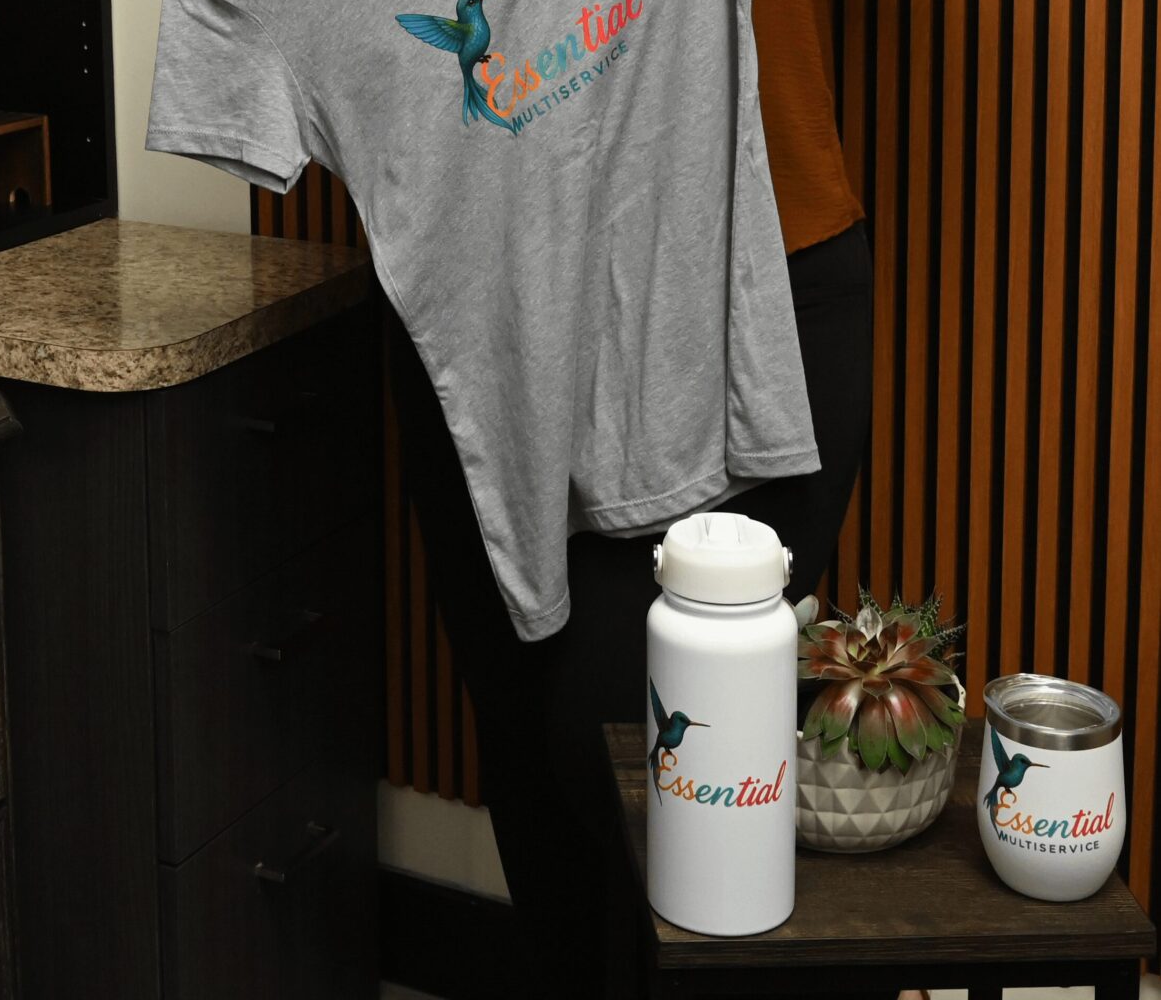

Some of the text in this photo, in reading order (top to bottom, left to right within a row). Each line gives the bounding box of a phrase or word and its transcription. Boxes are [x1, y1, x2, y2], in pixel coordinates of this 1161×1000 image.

[510, 40, 630, 135] MULTISERVICE
[656, 750, 787, 809] Essential
[992, 791, 1115, 840] Essential
[999, 829, 1101, 855] MULTISERVICE
